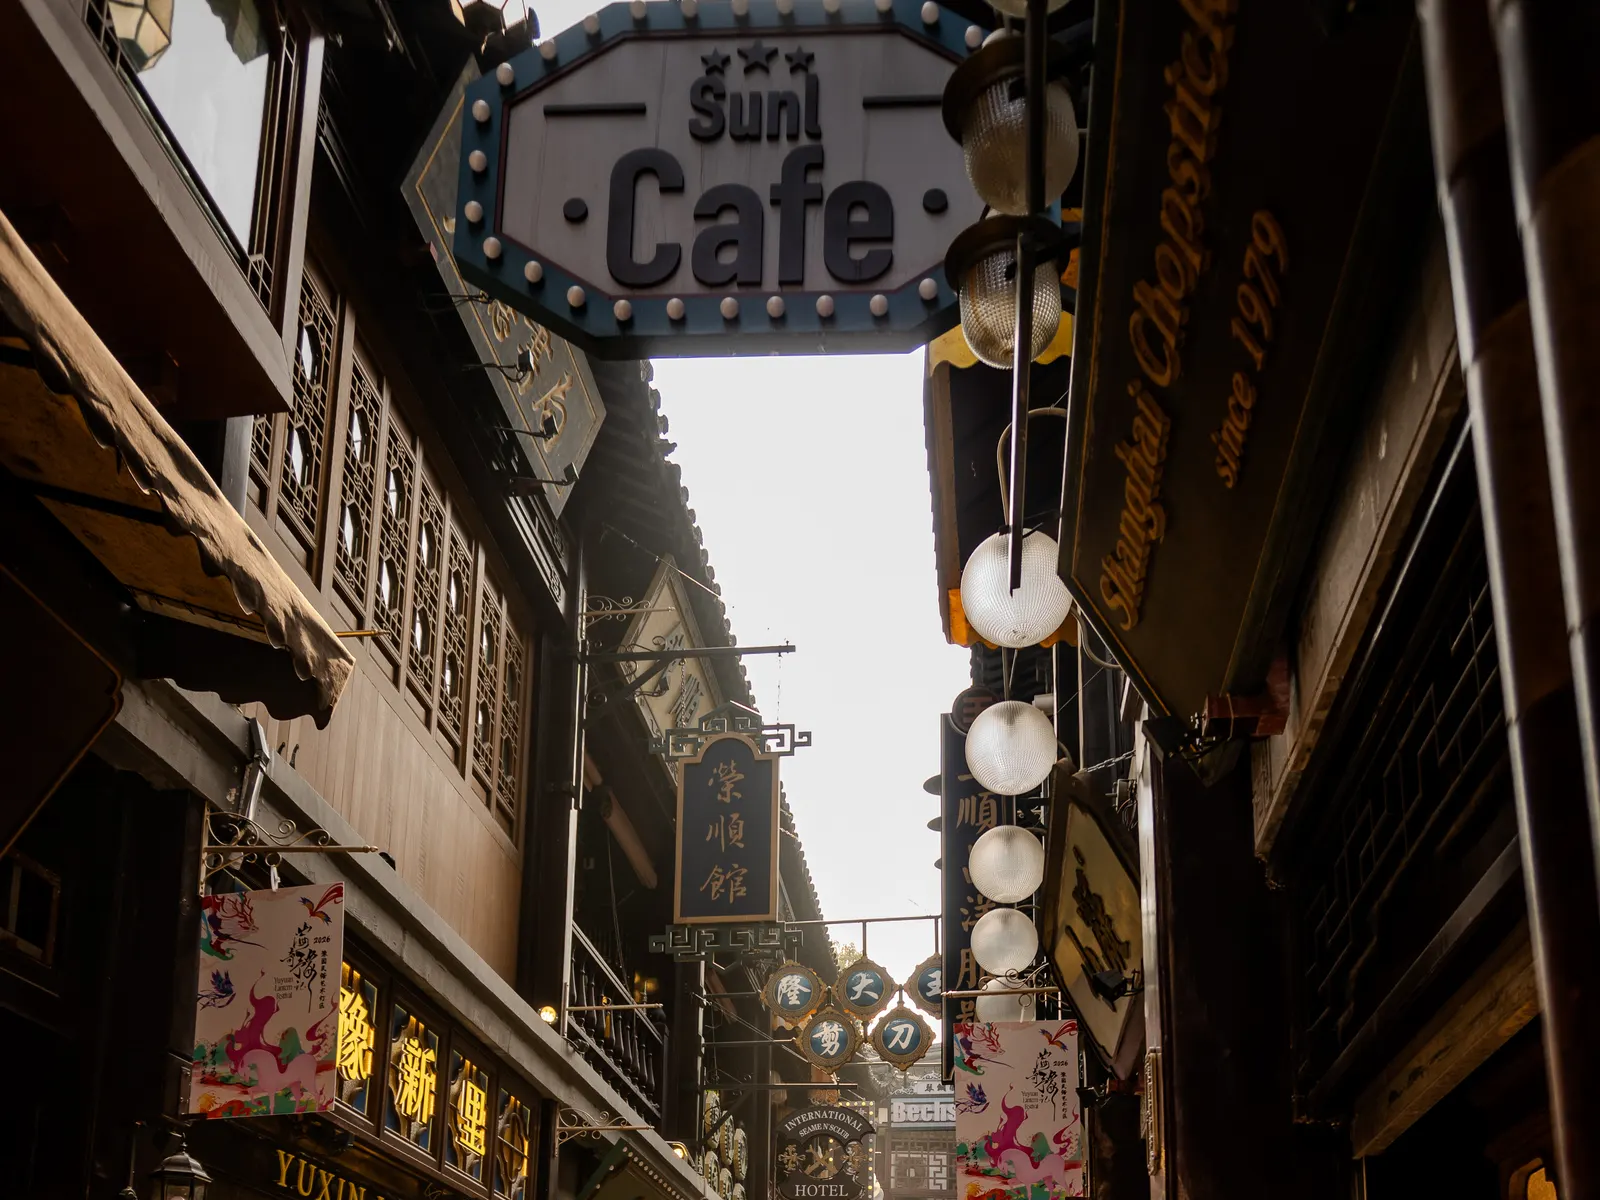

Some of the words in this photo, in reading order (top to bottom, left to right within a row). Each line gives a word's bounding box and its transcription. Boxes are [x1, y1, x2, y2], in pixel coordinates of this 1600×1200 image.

[606, 144, 894, 288] Cafe
[1231, 209, 1289, 372] 1979
[1208, 370, 1257, 489] since
[1100, 377, 1171, 631] Shanghai
[700, 759, 748, 904] 榮順館
[784, 1110, 863, 1132] INTERNATIONAL
[794, 1184, 849, 1197] HOTEL
